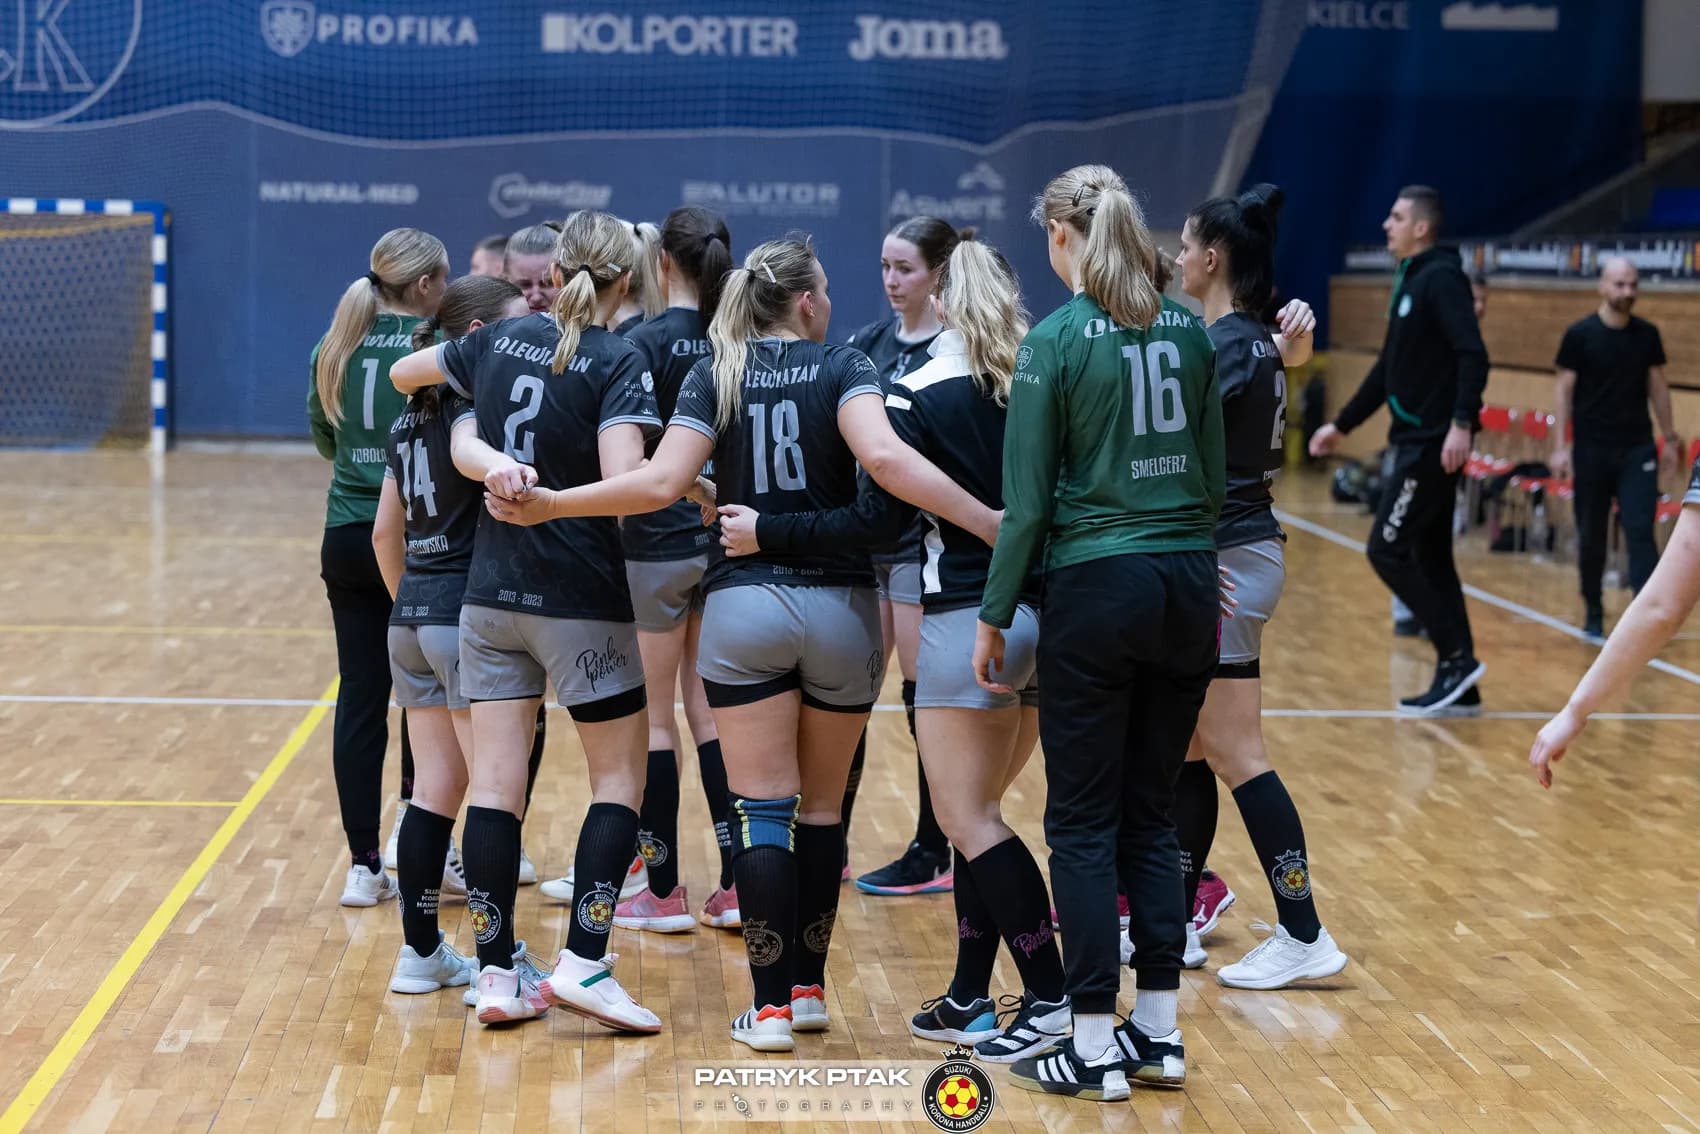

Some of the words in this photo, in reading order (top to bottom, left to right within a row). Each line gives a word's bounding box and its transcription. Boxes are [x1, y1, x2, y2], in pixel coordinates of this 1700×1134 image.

[318, 15, 479, 47] PROFIKA
[570, 15, 798, 57] KOLPORTER
[1306, 0, 1410, 30] KIELCE
[848, 16, 1008, 60] Joma
[362, 334, 413, 348] WIATA
[505, 340, 593, 373] LEWIAN
[361, 358, 379, 430] 1
[1014, 371, 1040, 385] OFIKA
[1121, 340, 1187, 436] 16
[503, 374, 544, 465] 2
[748, 399, 807, 495] 18
[396, 438, 438, 521] 14
[498, 589, 516, 603] 2013
[522, 592, 543, 607] 2023
